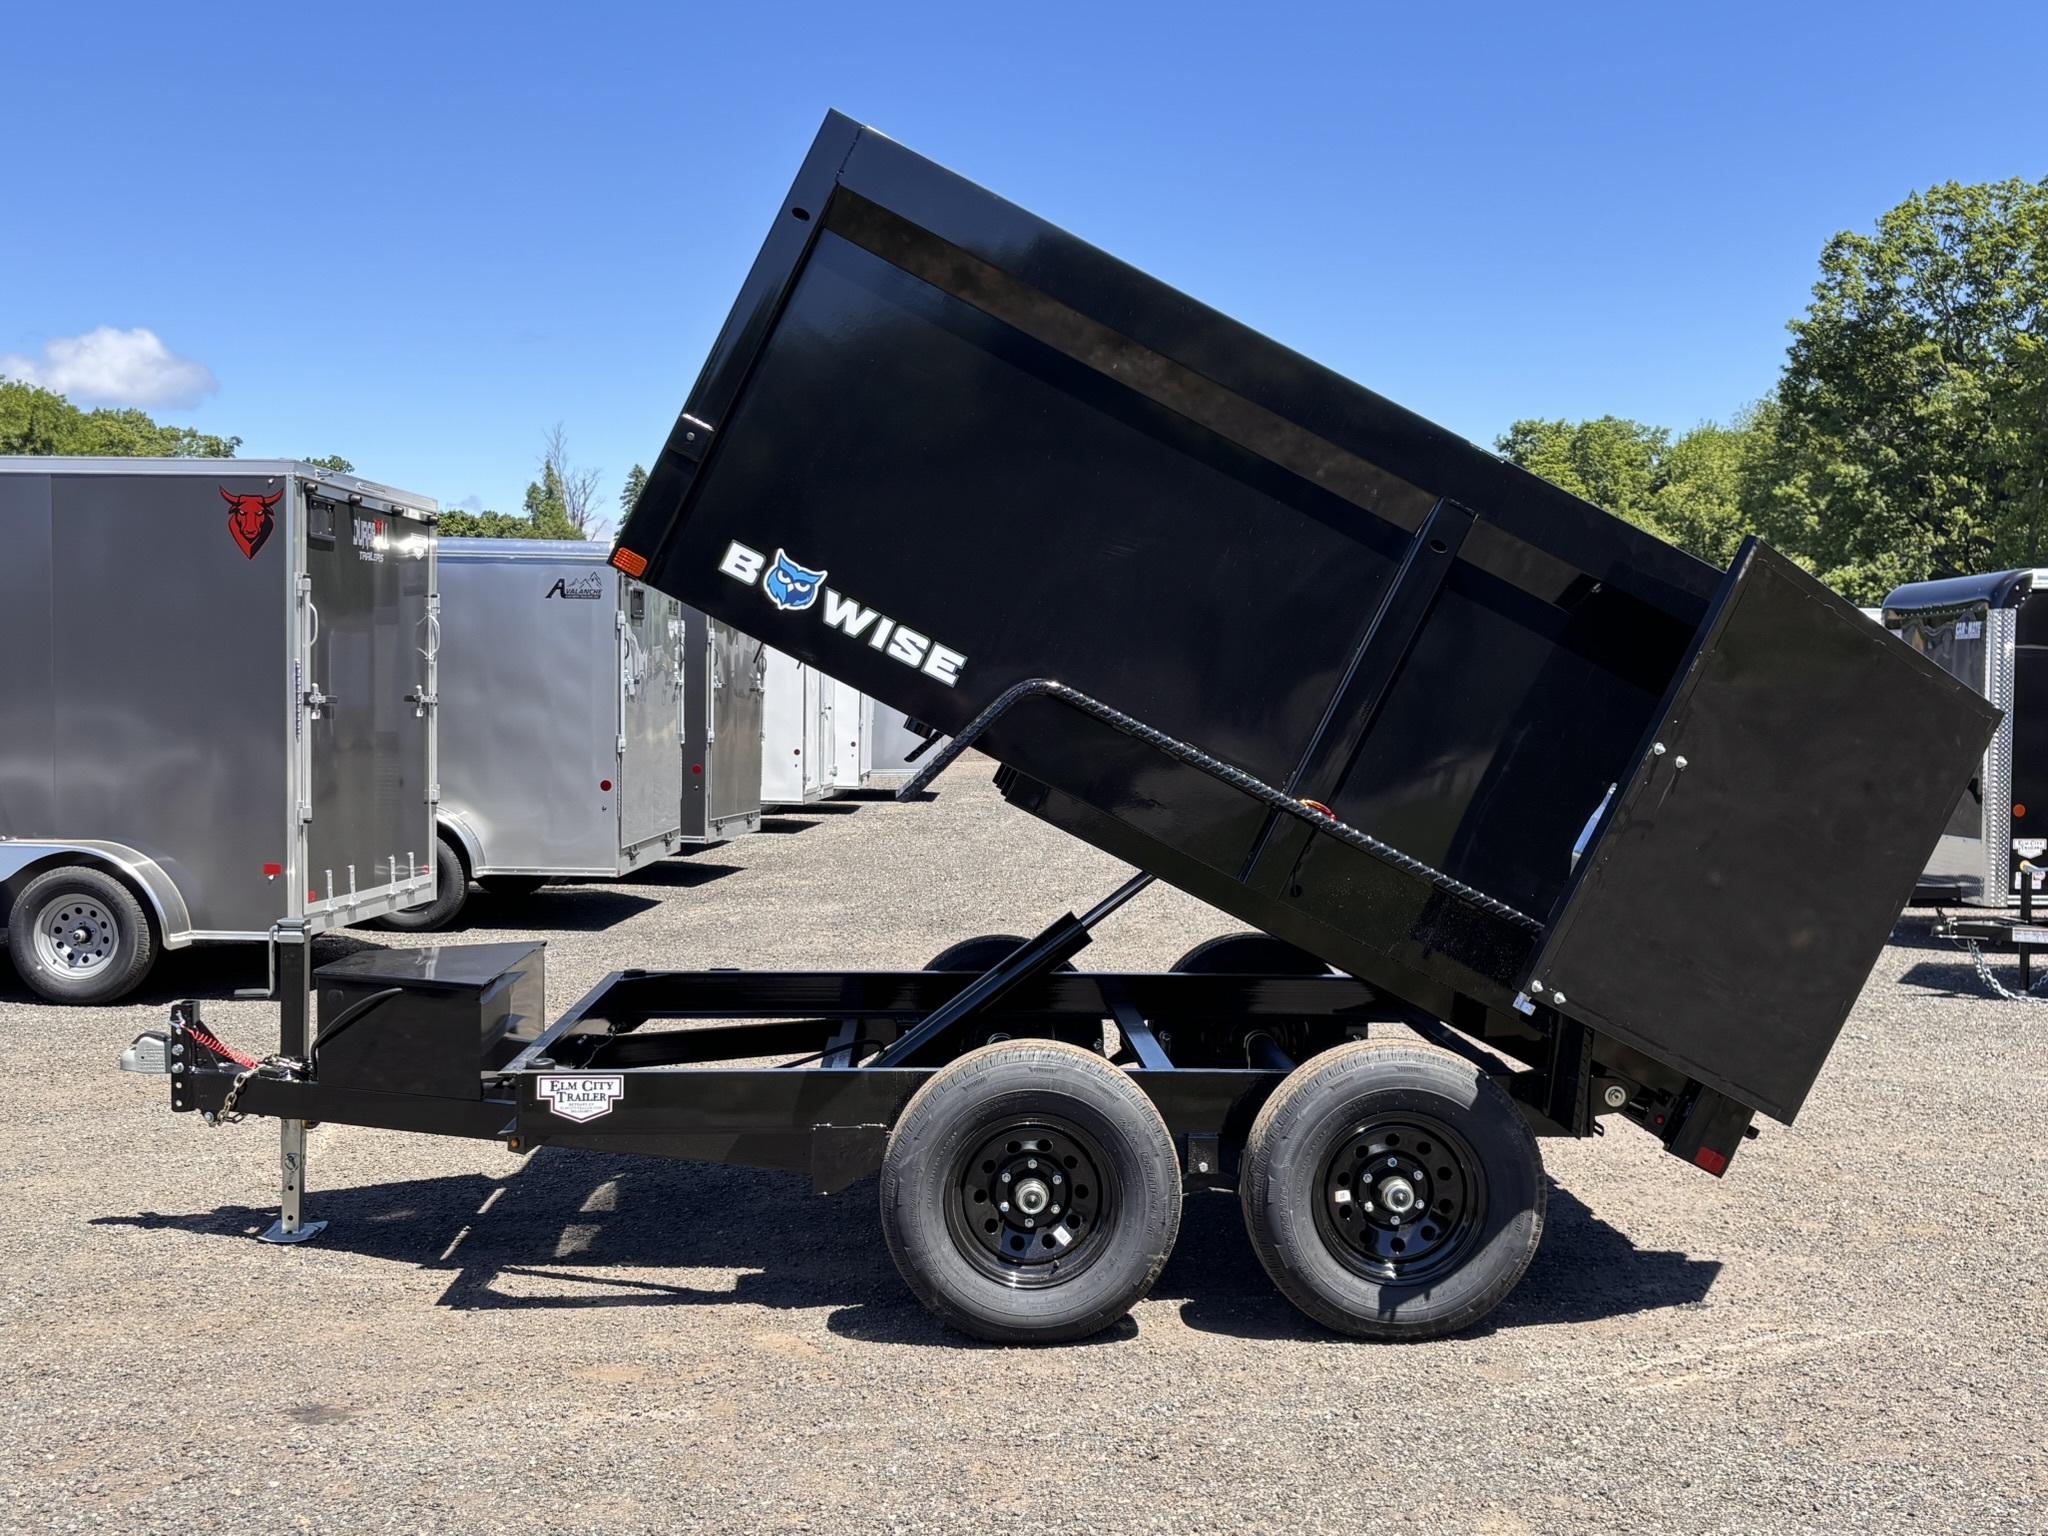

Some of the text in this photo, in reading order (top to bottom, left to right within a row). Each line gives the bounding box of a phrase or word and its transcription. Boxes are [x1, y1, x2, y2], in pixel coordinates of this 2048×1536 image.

[359, 550, 384, 563] TRAILERS
[545, 578, 603, 599] AVALANCHE
[550, 1080, 614, 1092] ELM CITY
[556, 1091, 607, 1103] TRAILER
